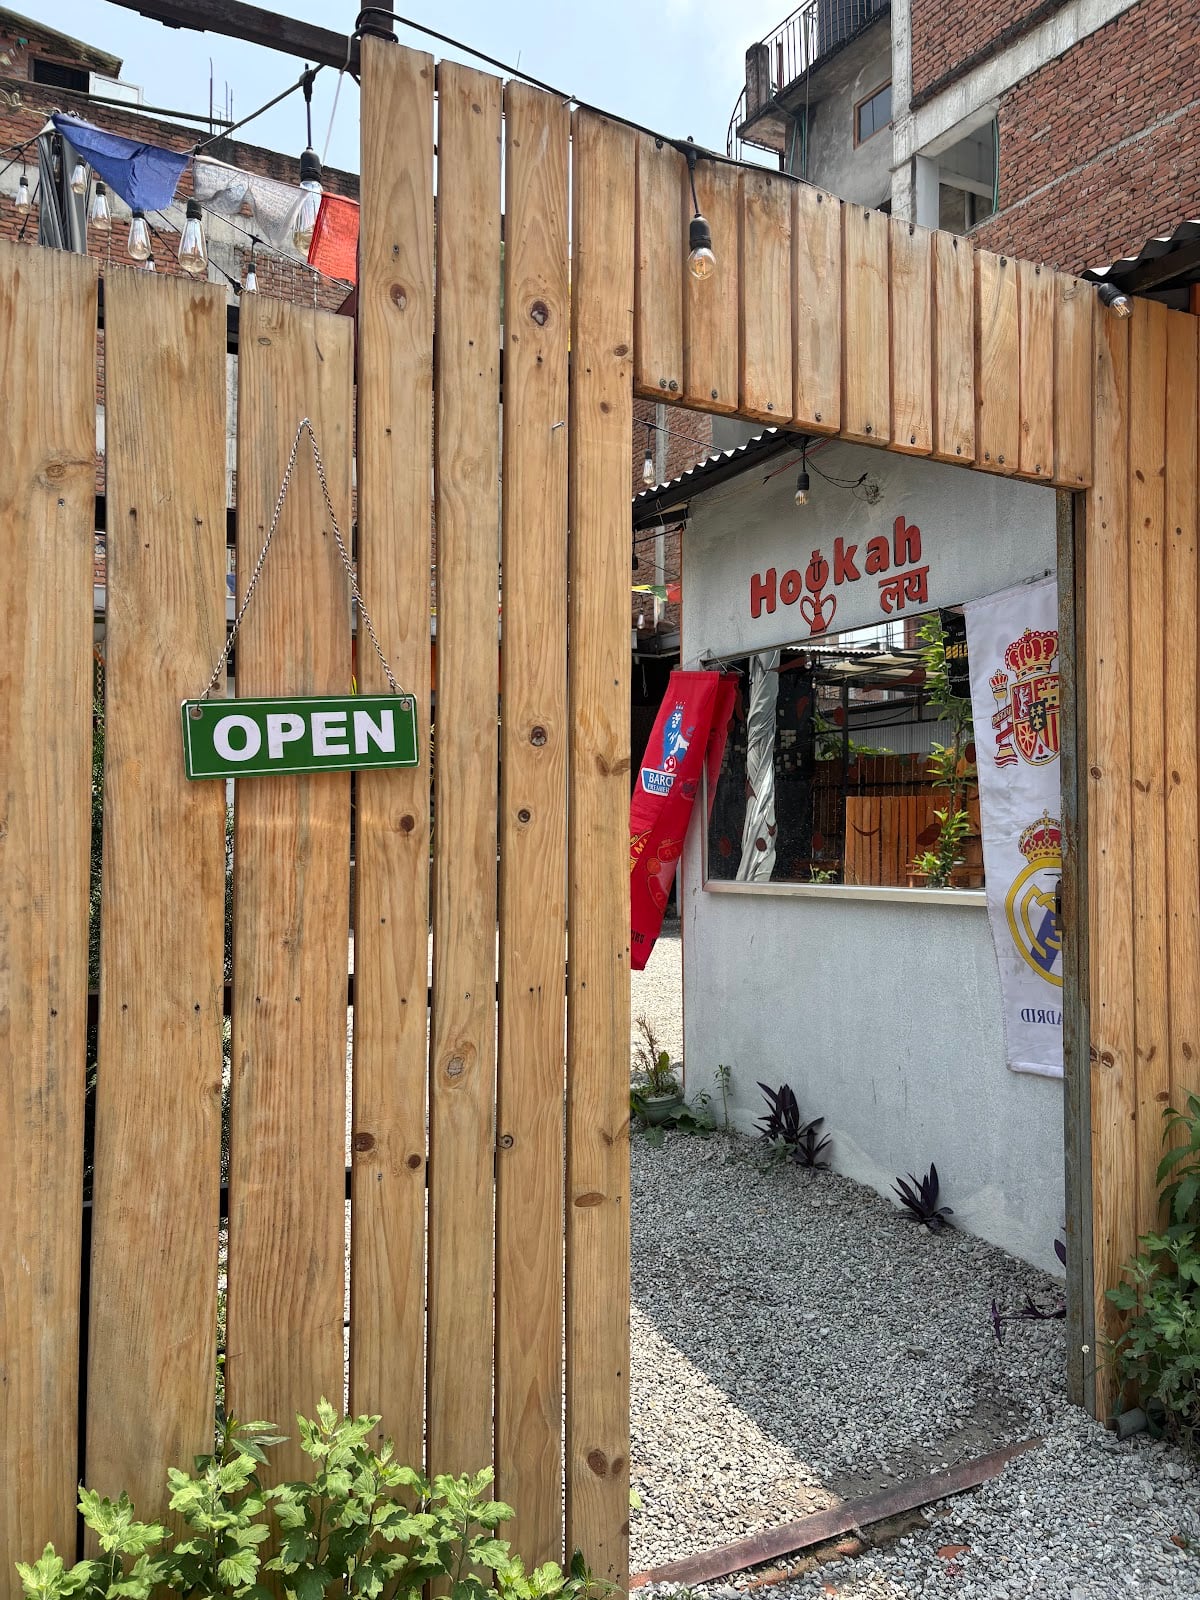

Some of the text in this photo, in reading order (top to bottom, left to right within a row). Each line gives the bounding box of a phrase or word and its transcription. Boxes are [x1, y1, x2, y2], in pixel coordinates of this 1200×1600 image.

[750, 515, 922, 619] Hookah
[878, 565, 930, 614] लय
[213, 709, 396, 762] OPEN
